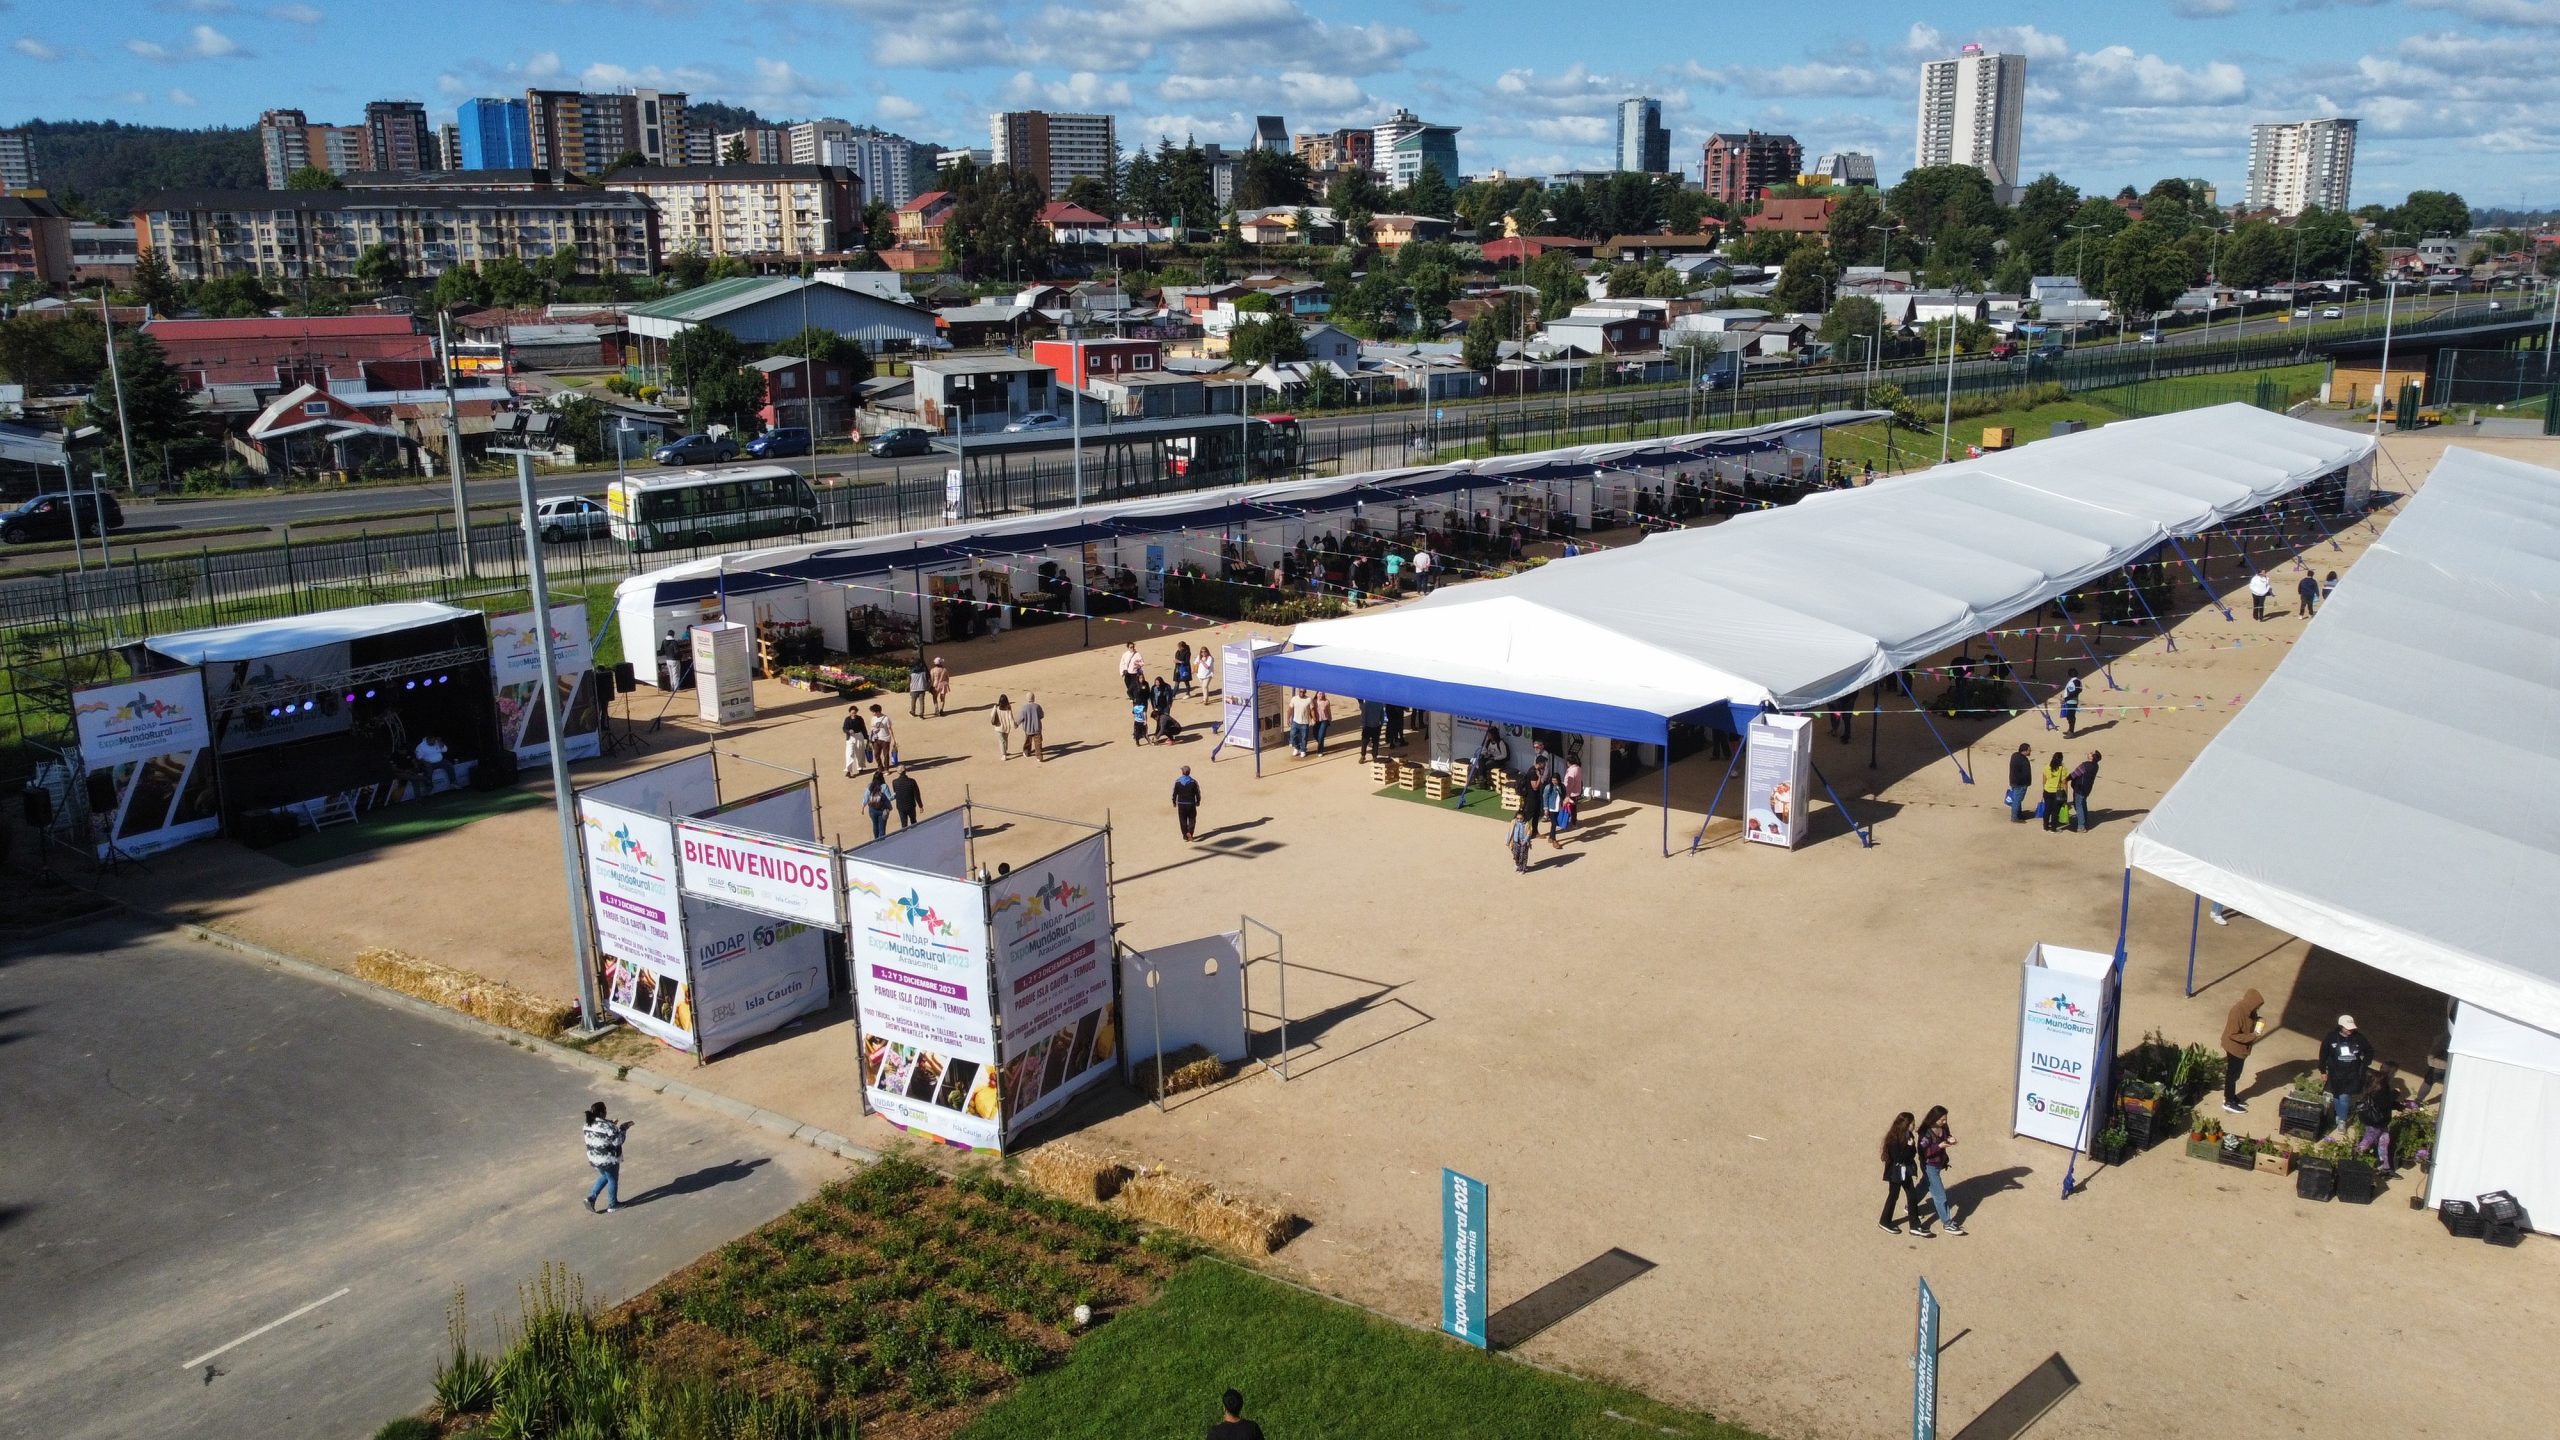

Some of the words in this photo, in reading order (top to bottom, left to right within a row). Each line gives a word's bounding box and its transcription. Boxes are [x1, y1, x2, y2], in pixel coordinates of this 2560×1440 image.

[685, 840, 828, 890] BIENVENIDOS
[1041, 914, 1063, 931] INDAP
[700, 933, 744, 960] INDAP
[869, 935, 946, 963] ExpoMundoRural
[946, 953, 970, 968] 2023
[903, 933, 929, 946] INDAP
[1010, 918, 1077, 962] ExpoMundoRural
[1042, 955, 1072, 975] DICIEMBRE
[1072, 948, 1086, 961] 2023
[746, 997, 765, 1010] Isla
[767, 981, 802, 1001] Cautín
[904, 975, 938, 991] DICIEMBRE
[938, 984, 956, 995] 2023
[1015, 991, 1035, 1011] PARQUE
[1037, 985, 1049, 998] ISLA
[1050, 973, 1068, 991] CAUTÍN
[1073, 960, 1096, 978] TEMUCO
[874, 985, 897, 1000] PARQUE
[898, 991, 912, 1004] ISLA
[914, 995, 937, 1010] CAUTÍN
[943, 1002, 971, 1018] TEMUCO
[2028, 1014, 2093, 1035] ExpoMundoRural
[2051, 1013, 2069, 1021] INDAP
[937, 1027, 958, 1038] TALLERES
[964, 1034, 986, 1045] CHARLAS
[2031, 1051, 2082, 1074] INDAP
[874, 1097, 895, 1107] INDAP
[2049, 1103, 2080, 1118] CAMPO
[1453, 1176, 1468, 1212] 2023
[1453, 1209, 1469, 1335] ExpoMundoRural
[1920, 1289, 1931, 1328] 2023
[1917, 1328, 1928, 1440] oMundoRural
